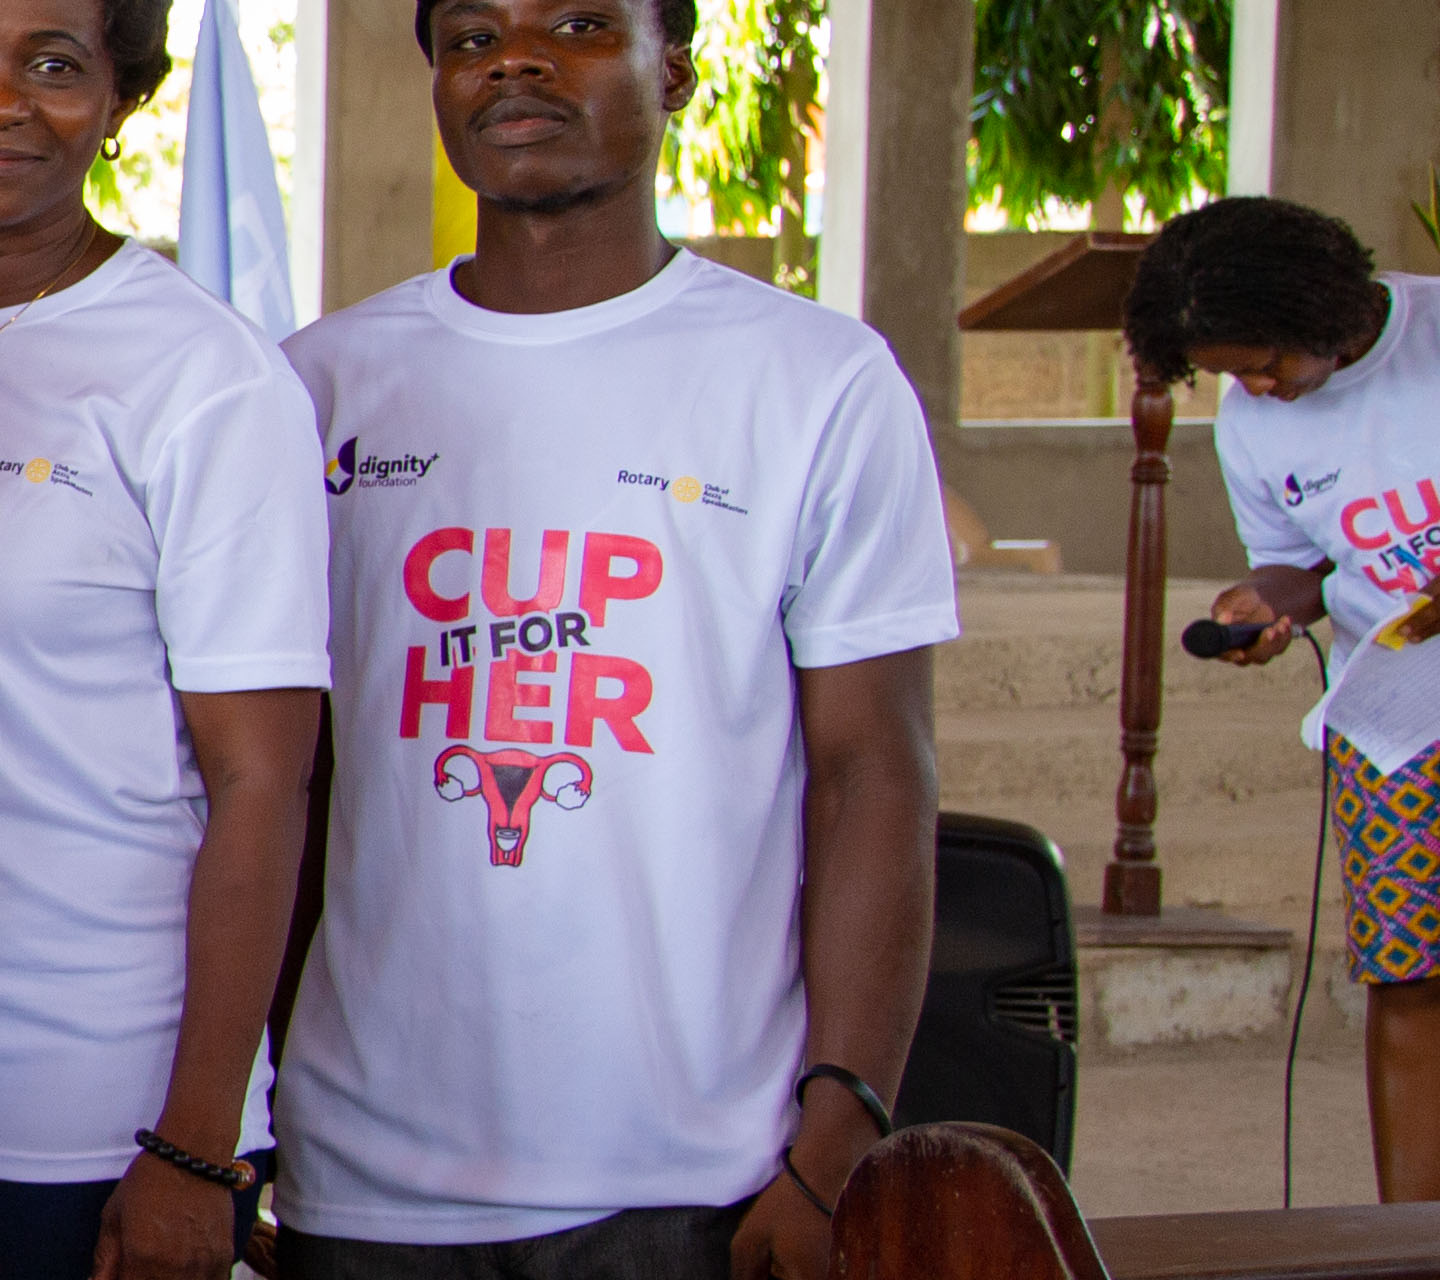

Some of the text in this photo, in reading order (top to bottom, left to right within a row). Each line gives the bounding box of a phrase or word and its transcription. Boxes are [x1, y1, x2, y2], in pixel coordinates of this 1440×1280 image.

[359, 478, 416, 487] foundation
[618, 470, 669, 491] Rotary
[1340, 479, 1440, 551] CU
[1408, 527, 1440, 555] FO
[403, 527, 663, 628] CUP
[440, 612, 590, 667] IT FOR
[399, 645, 655, 754] HER
